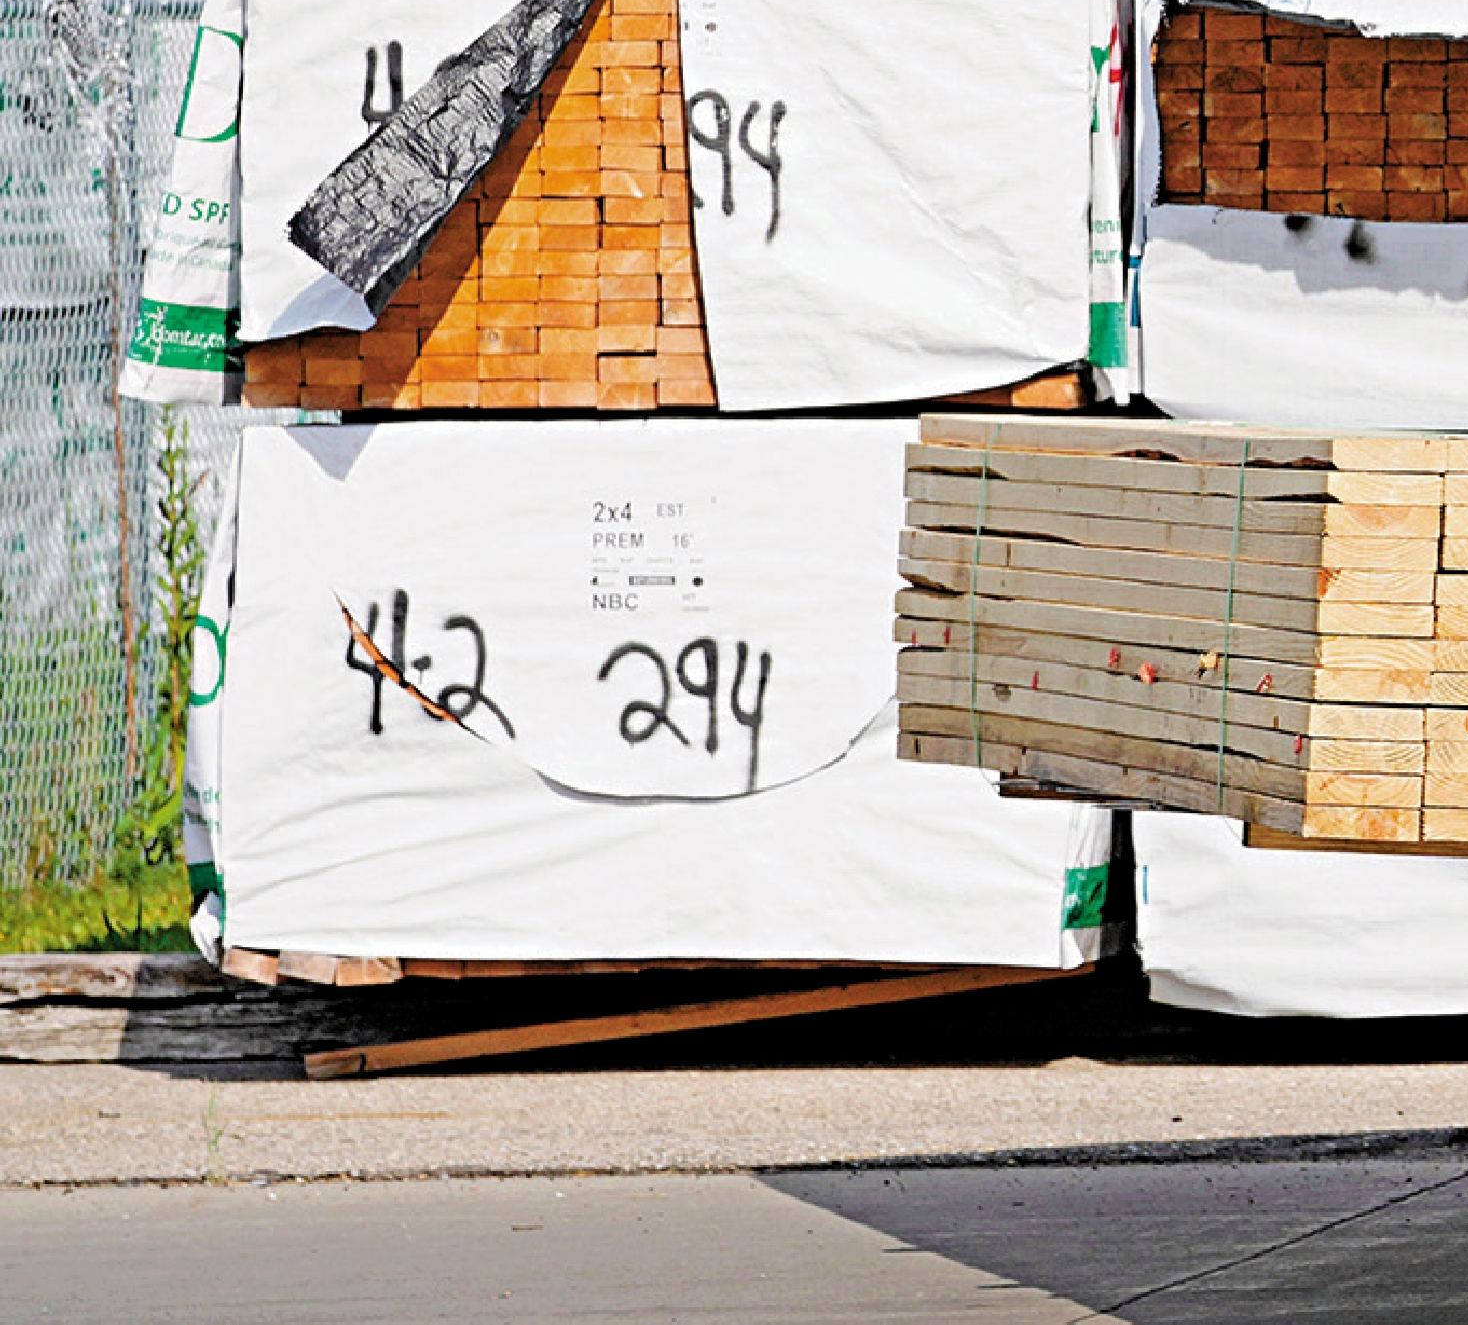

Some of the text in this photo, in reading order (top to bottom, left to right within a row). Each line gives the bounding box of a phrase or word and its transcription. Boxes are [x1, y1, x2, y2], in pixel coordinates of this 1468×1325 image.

[686, 89, 788, 243] 94
[593, 500, 684, 523] 2x4 EST
[593, 532, 645, 549] PREM
[593, 592, 639, 611] NBC
[599, 638, 772, 792] 294
